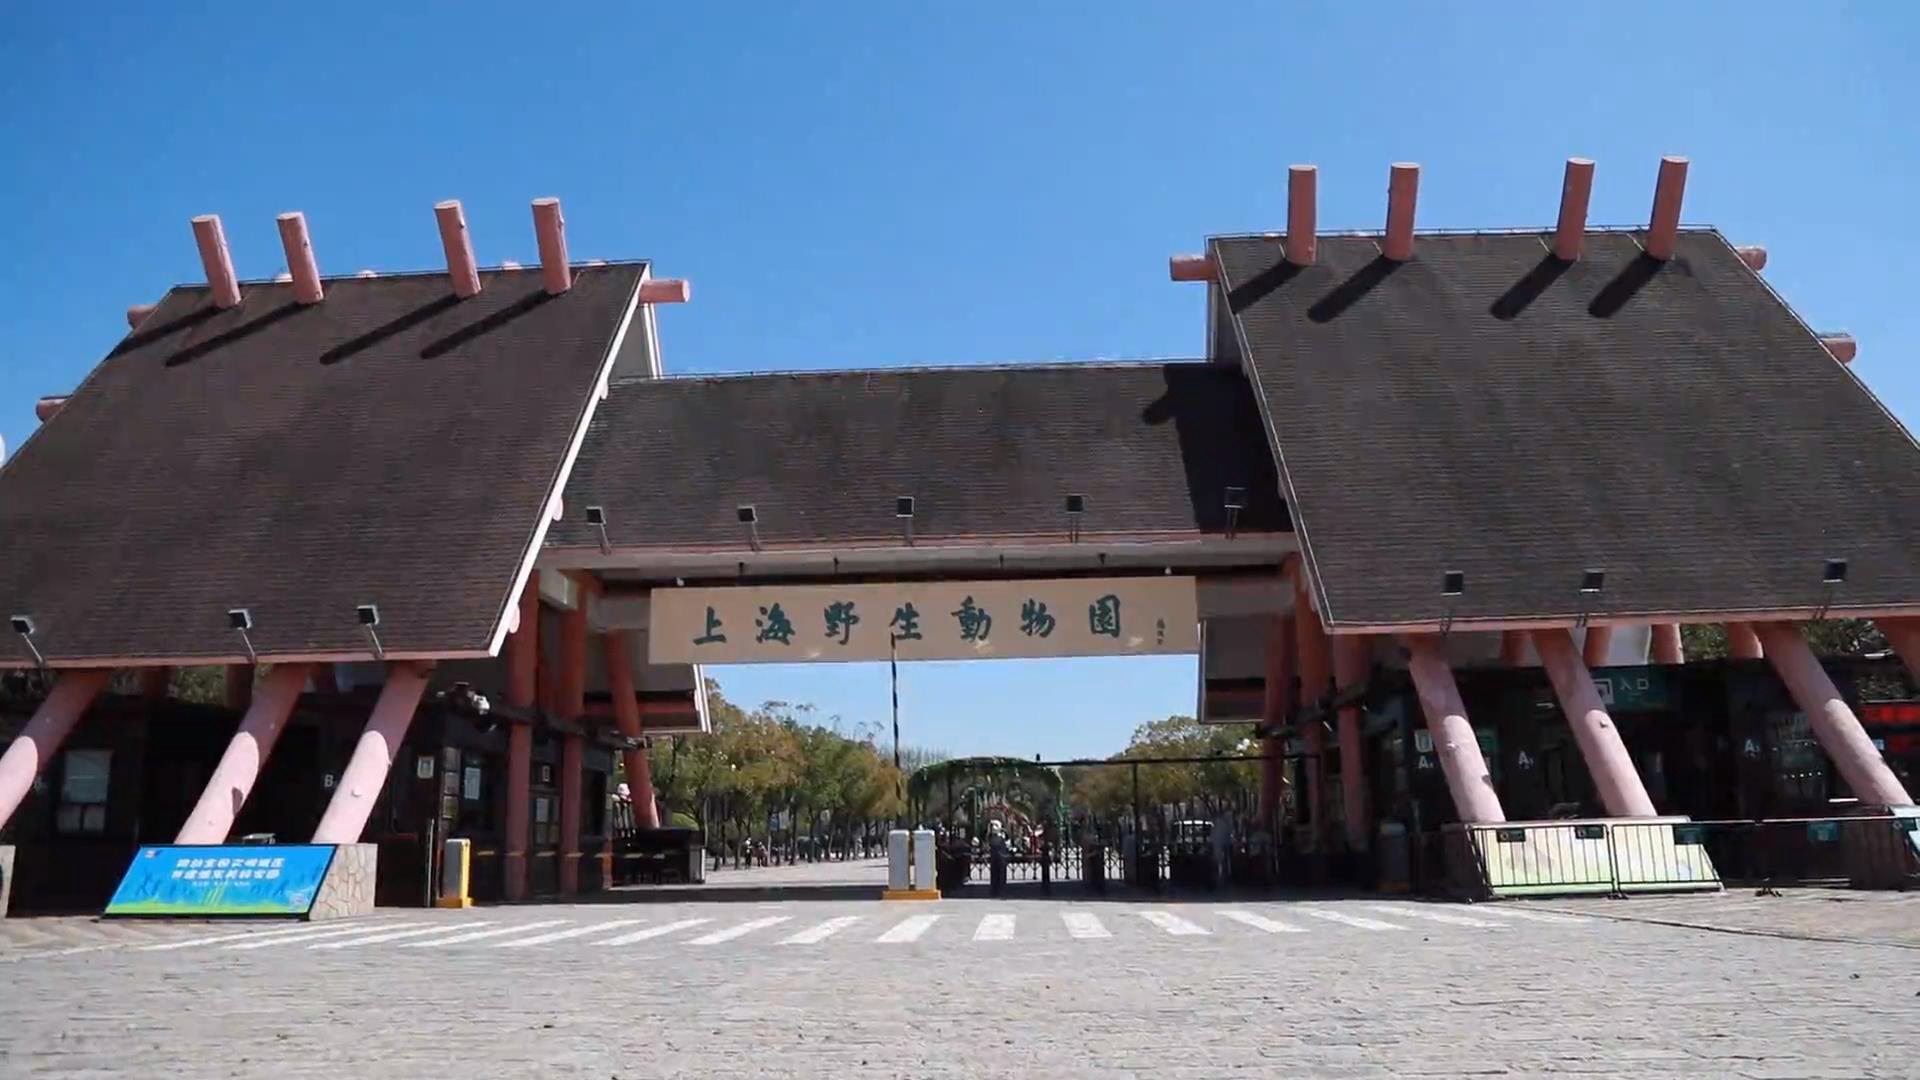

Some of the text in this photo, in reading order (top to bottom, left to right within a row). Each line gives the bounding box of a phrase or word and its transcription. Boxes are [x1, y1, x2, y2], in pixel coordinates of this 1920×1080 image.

[692, 593, 1121, 646] 上海野生動物園
[1619, 677, 1648, 690] 入口
